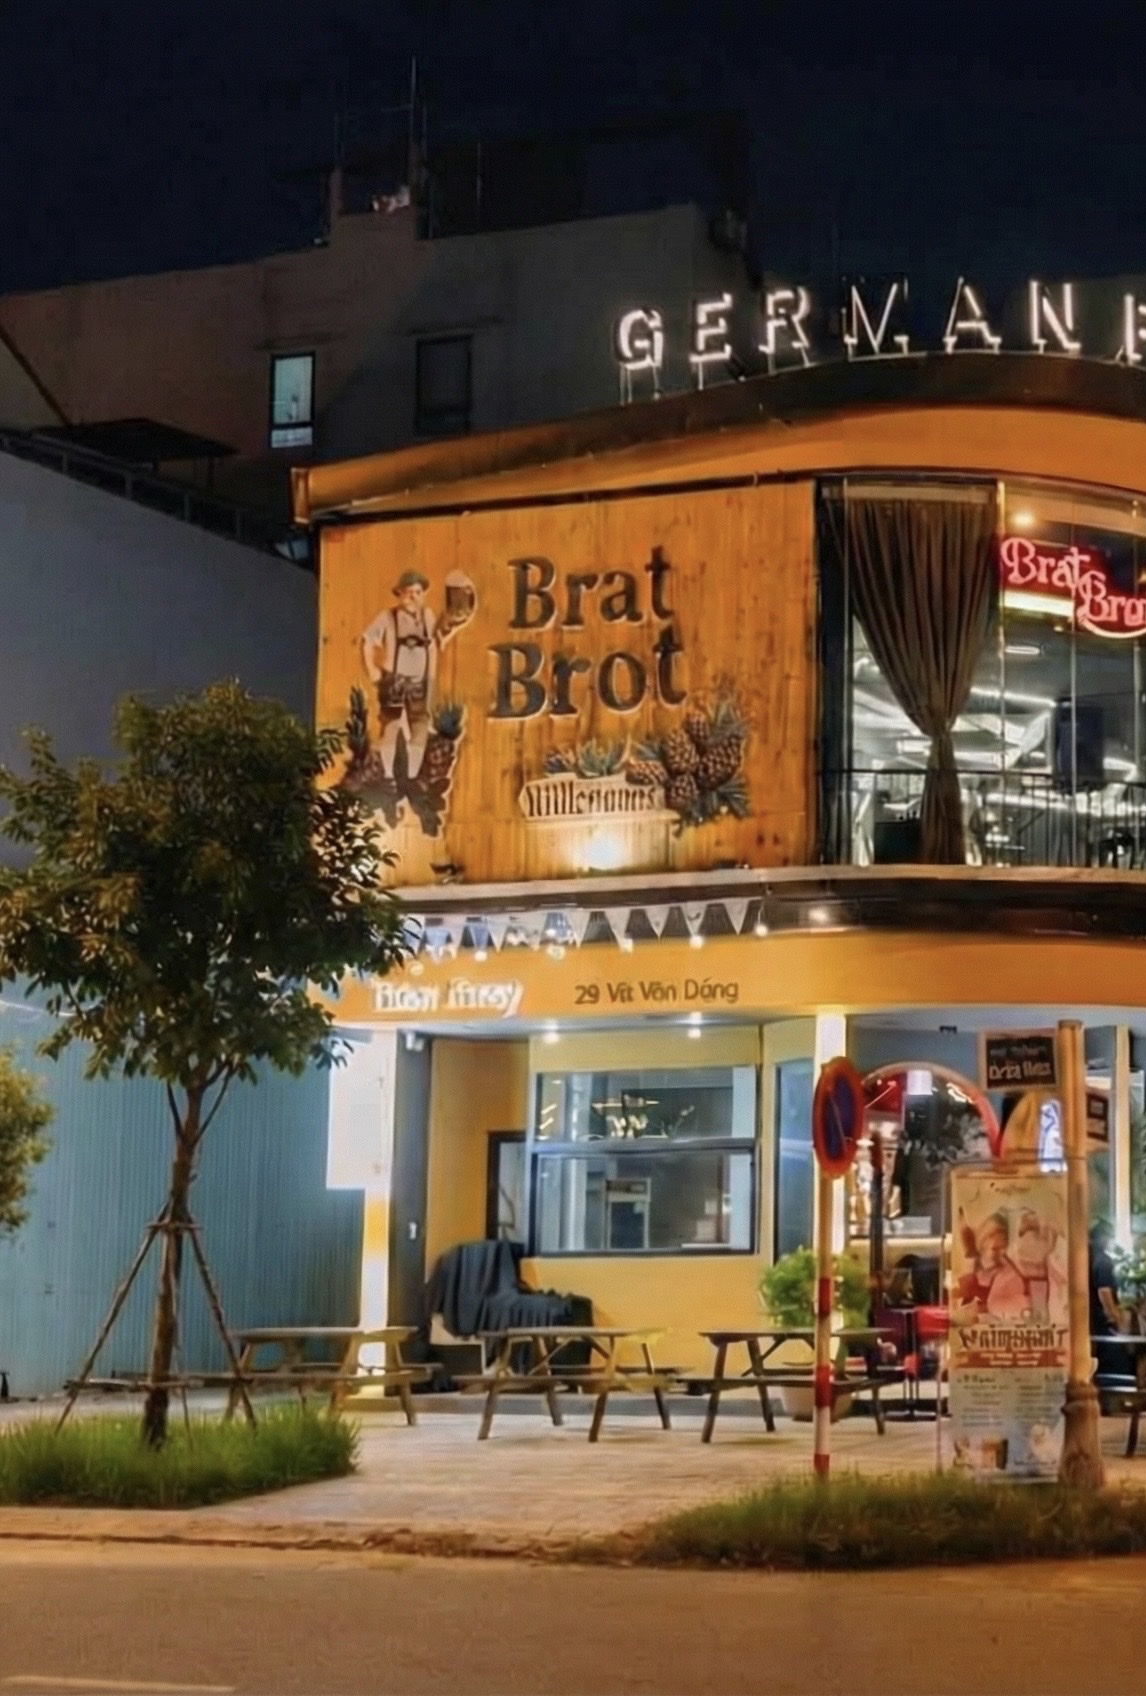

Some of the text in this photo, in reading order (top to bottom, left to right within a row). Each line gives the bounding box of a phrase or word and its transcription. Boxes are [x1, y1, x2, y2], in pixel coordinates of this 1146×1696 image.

[615, 277, 1080, 370] GERMAN
[507, 545, 676, 631] Brat
[1000, 537, 1091, 590] Brat
[487, 624, 689, 721] Brot
[574, 983, 600, 1005] 29
